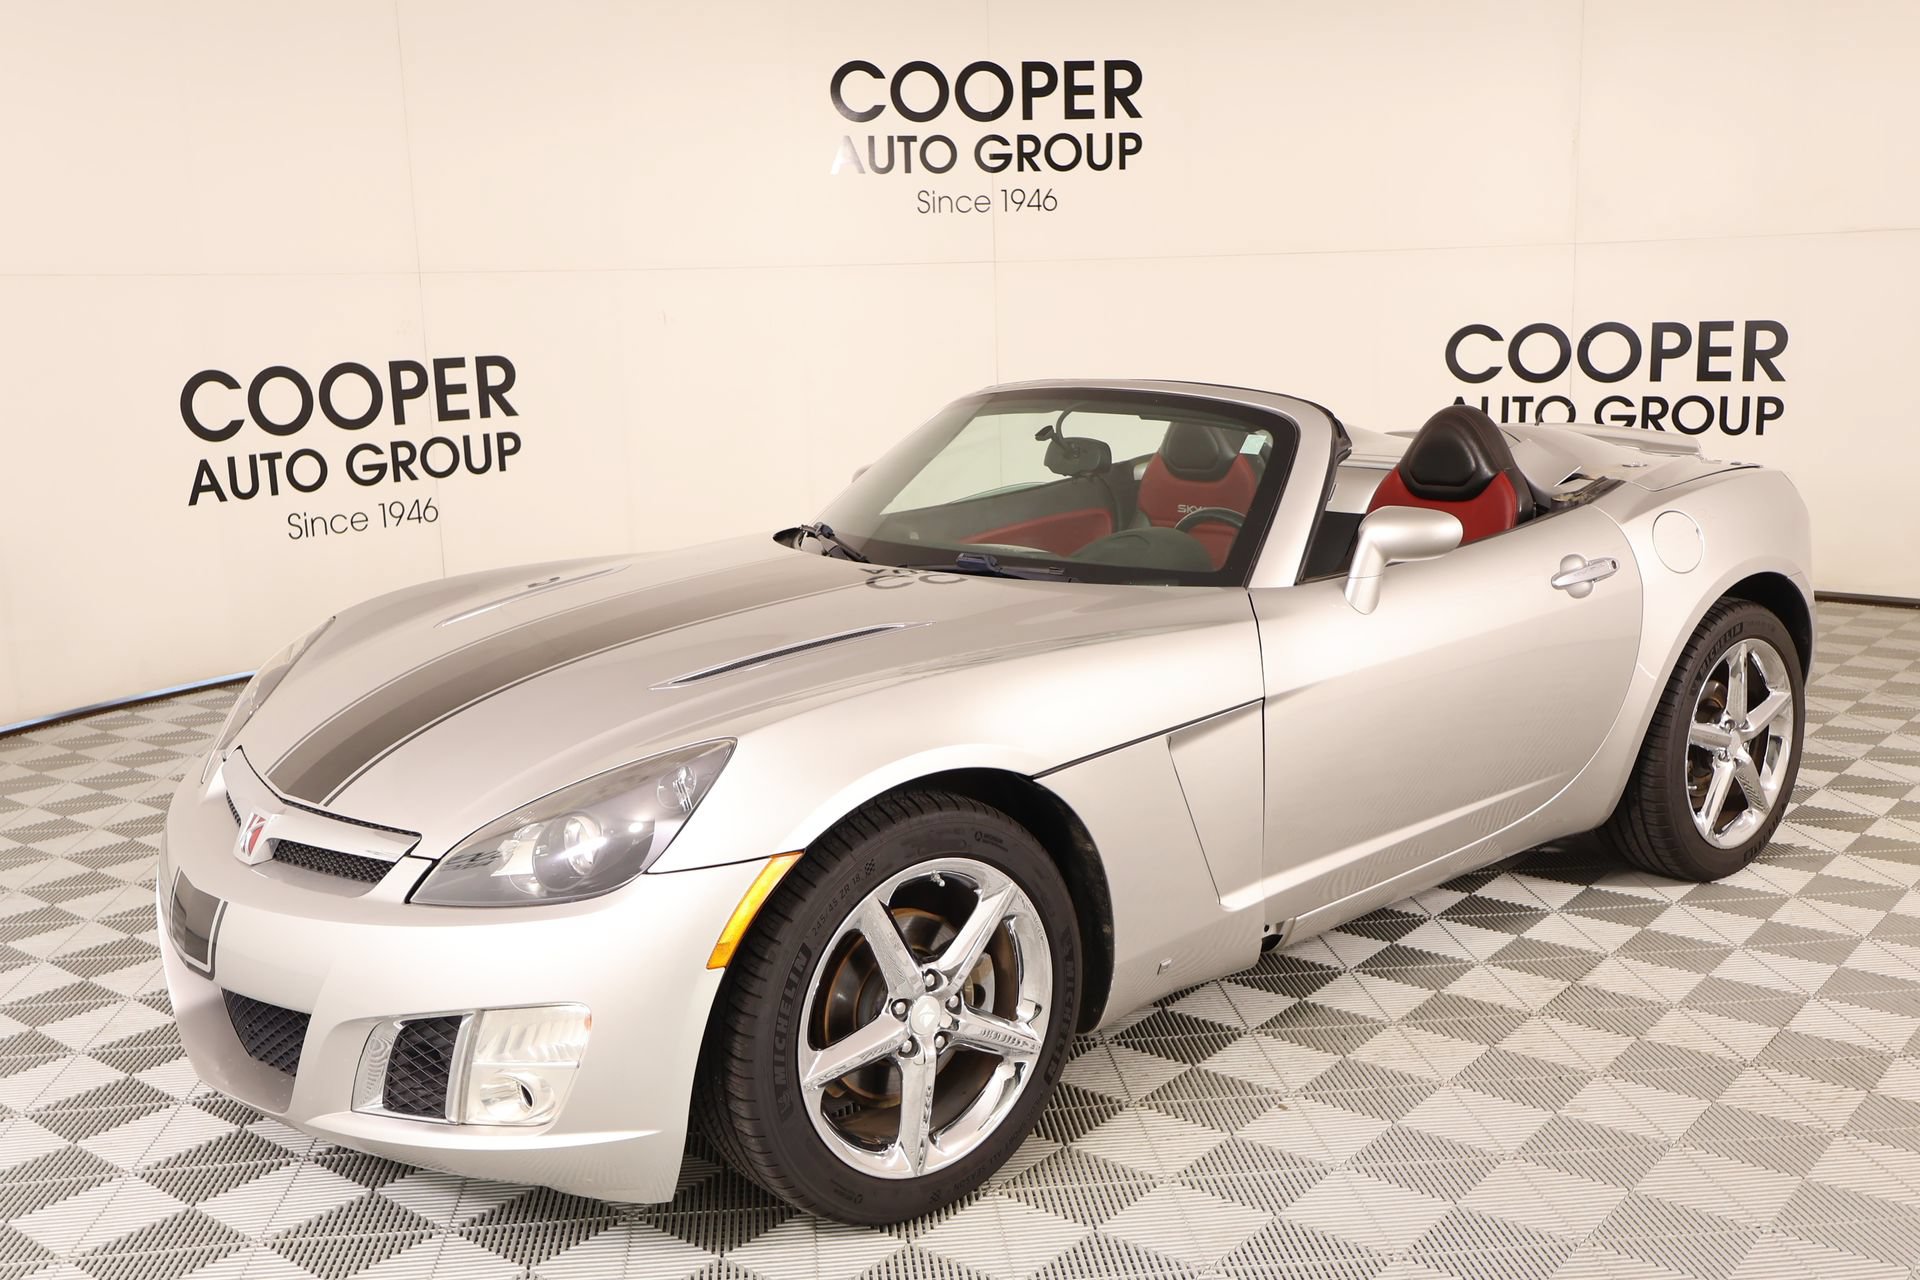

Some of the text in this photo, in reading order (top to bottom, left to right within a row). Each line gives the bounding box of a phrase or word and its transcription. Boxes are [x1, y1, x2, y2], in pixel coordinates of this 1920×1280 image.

[830, 60, 1143, 122] COOPER
[830, 132, 1143, 175] AUTO GROUP
[916, 188, 1058, 214] Since 1946
[1445, 320, 1789, 383] COOPER
[180, 355, 519, 442] COOPER
[1594, 395, 1785, 436] GROUP
[188, 431, 522, 506] AUTO GROUP
[287, 497, 439, 540] Since 1946
[774, 953, 808, 1086] MICHELIN
